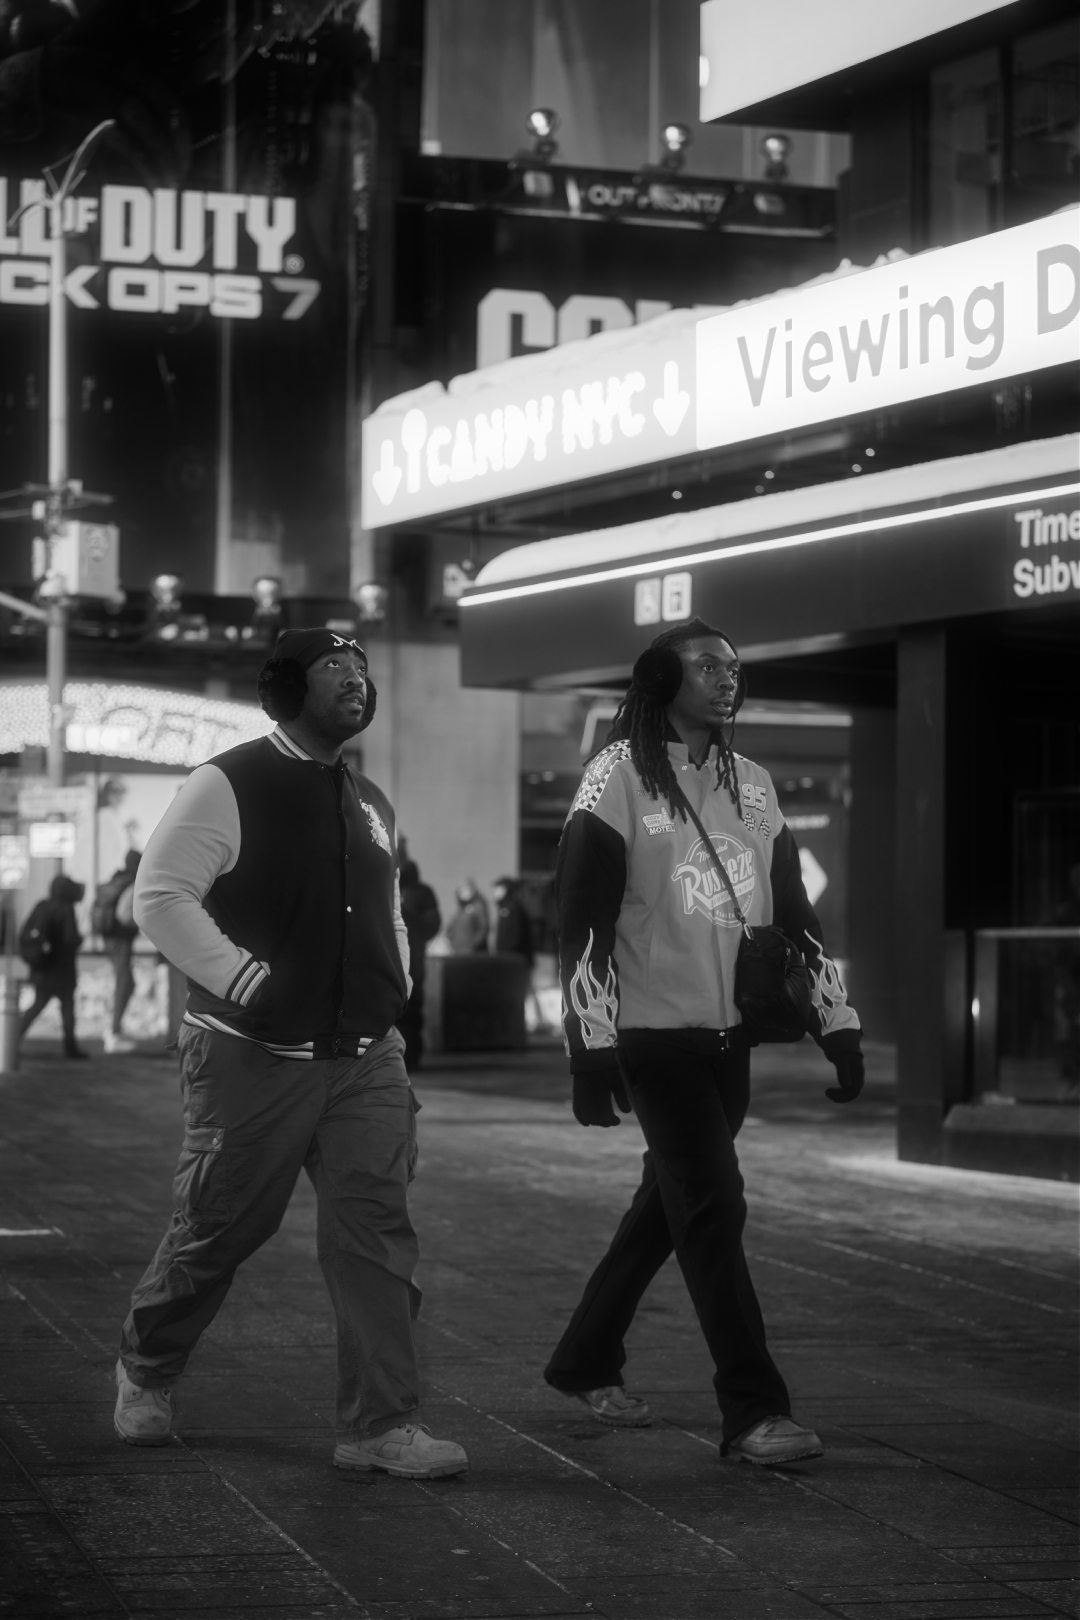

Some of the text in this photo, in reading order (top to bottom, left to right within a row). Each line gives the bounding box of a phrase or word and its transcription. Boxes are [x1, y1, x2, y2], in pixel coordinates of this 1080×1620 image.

[101, 184, 297, 273] DUTY
[108, 267, 262, 319] OPS
[270, 277, 321, 320] 7
[736, 281, 1006, 407] Viewing
[562, 371, 646, 454] NYC
[649, 824, 676, 835] MOTEL
[741, 783, 767, 812] 95
